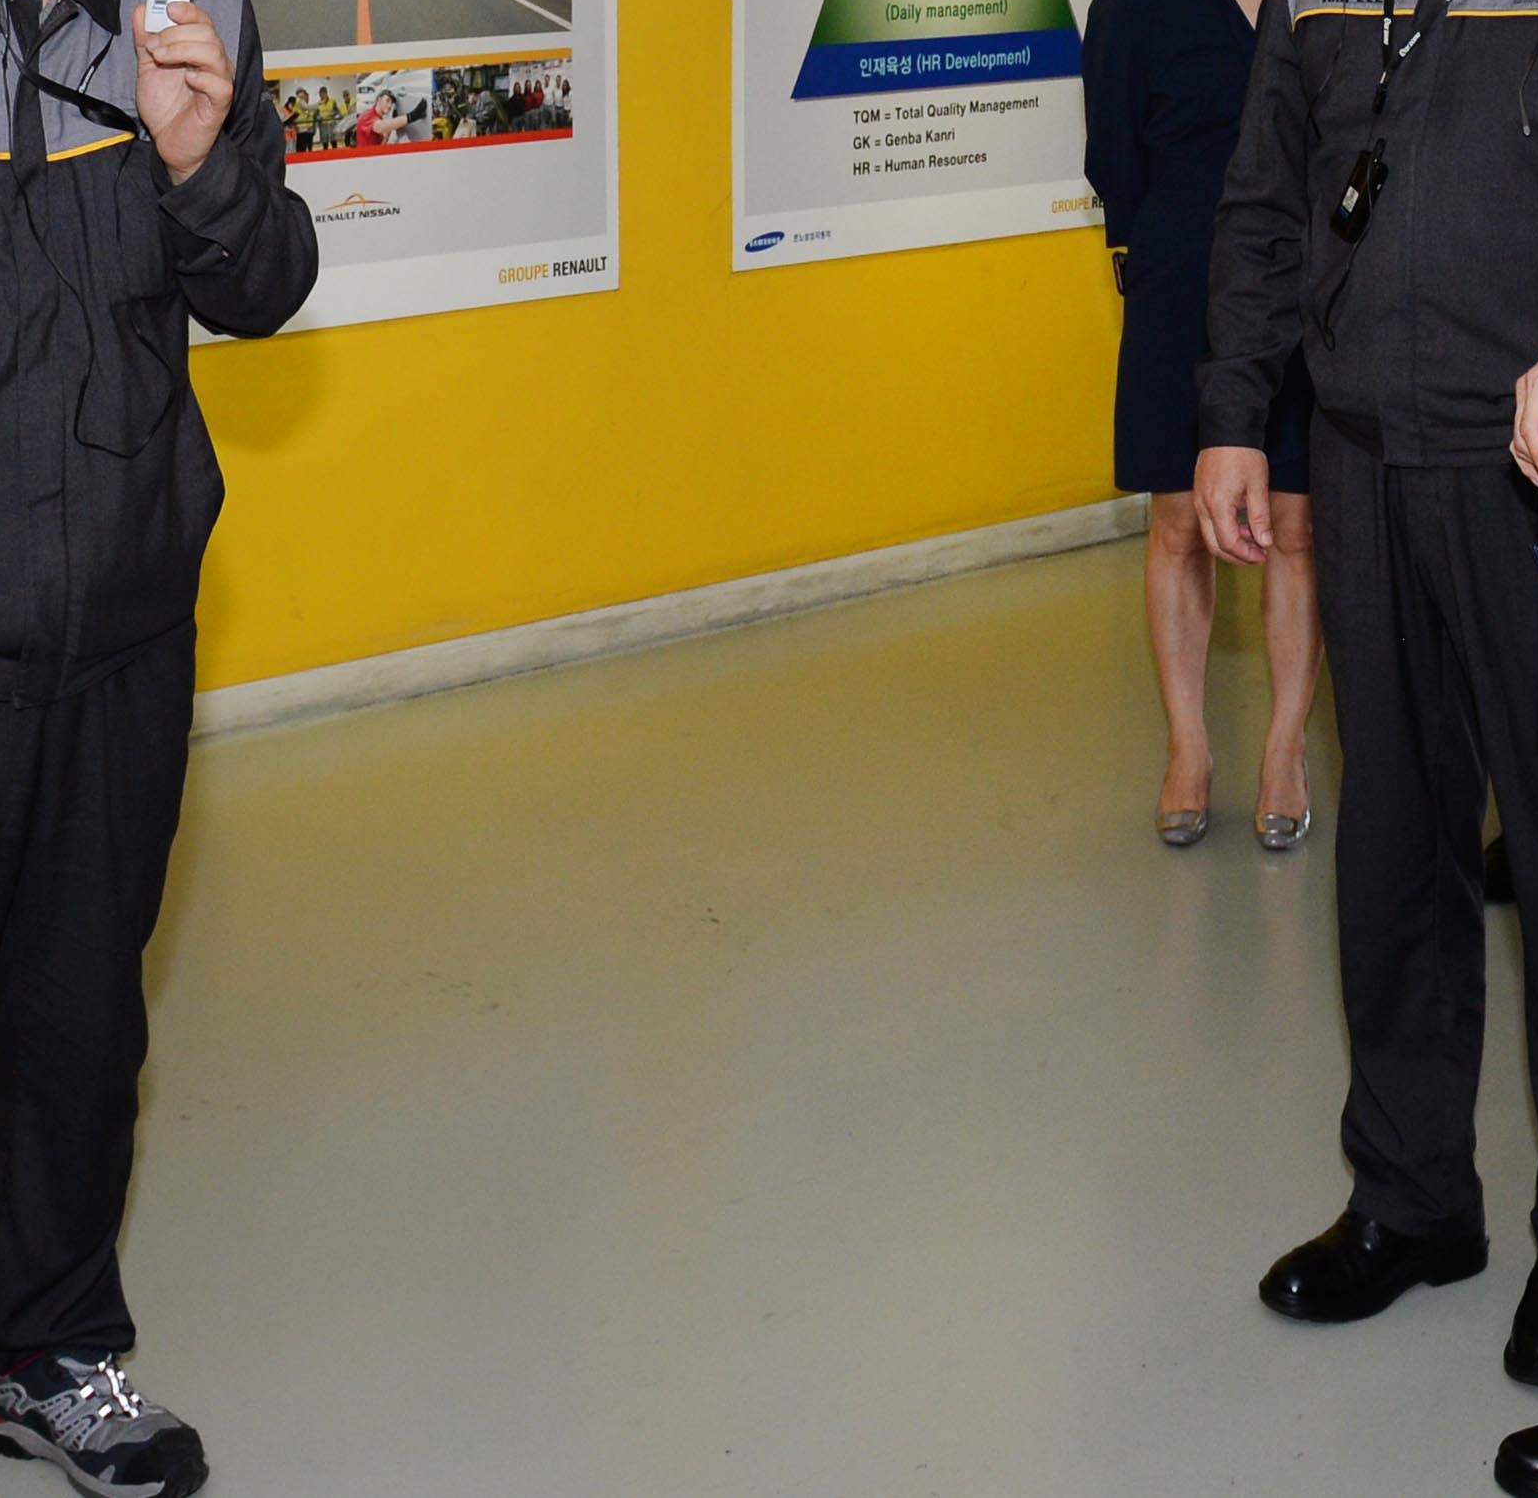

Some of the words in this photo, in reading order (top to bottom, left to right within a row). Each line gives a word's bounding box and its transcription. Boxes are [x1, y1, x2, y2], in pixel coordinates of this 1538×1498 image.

[886, 3, 922, 23] (Daily
[860, 56, 912, 77] 인재육성
[917, 53, 942, 75] (HR
[946, 46, 1031, 72] Development)
[853, 109, 880, 125] TQM
[895, 105, 924, 121] Total
[927, 102, 966, 120] Quality
[969, 95, 1039, 116] Management
[852, 136, 871, 150] GK
[884, 131, 921, 147] Genba
[925, 128, 955, 144] Kanri
[852, 161, 871, 176] HR
[884, 156, 925, 172] Human
[928, 151, 987, 169] Resources
[315, 211, 355, 224] RENAULT
[358, 205, 401, 219] NISSAN
[1051, 196, 1090, 214] GROUPE
[498, 262, 549, 284] GROUPE
[552, 255, 607, 279] RENAULT
